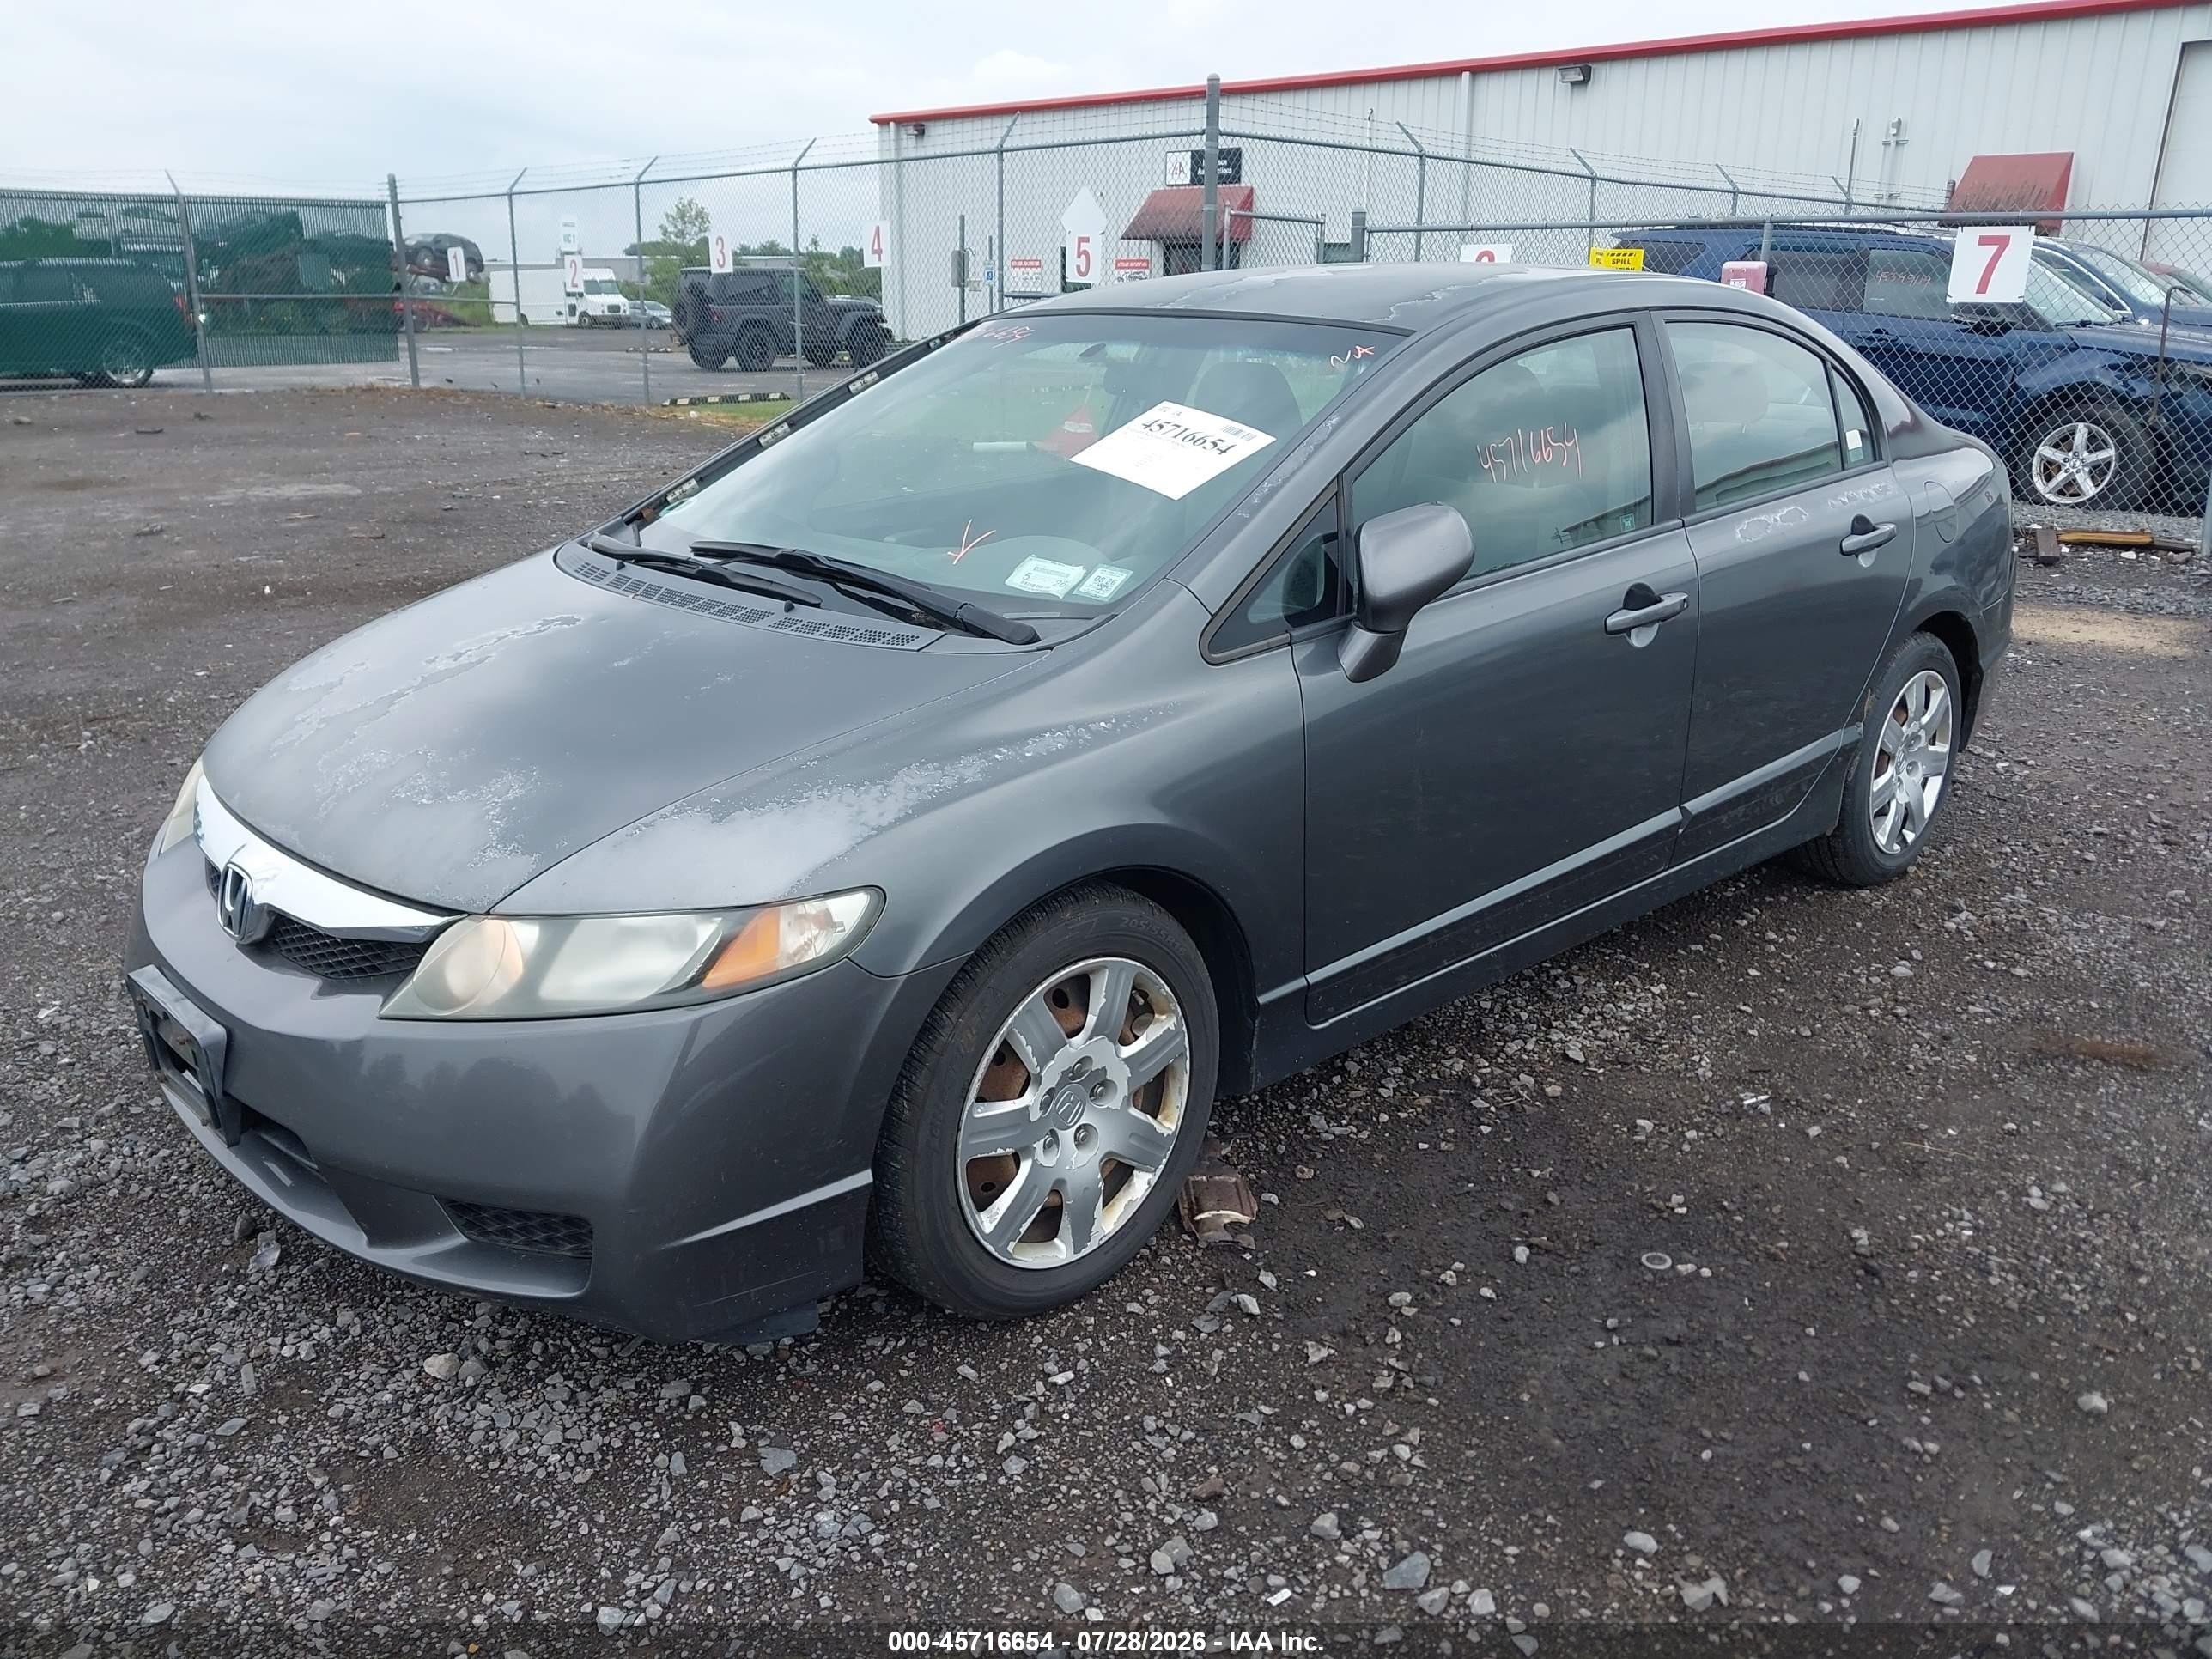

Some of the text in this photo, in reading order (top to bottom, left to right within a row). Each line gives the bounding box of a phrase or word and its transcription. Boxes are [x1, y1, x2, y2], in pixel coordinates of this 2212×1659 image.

[716, 235, 726, 268] 3
[871, 225, 883, 261] 4
[1076, 236, 1091, 277] 5
[453, 252, 459, 277] 1
[570, 259, 579, 288] 2
[1976, 234, 2011, 294] 7
[1142, 419, 1237, 455] 45716654
[1476, 422, 1582, 483] 45716654
